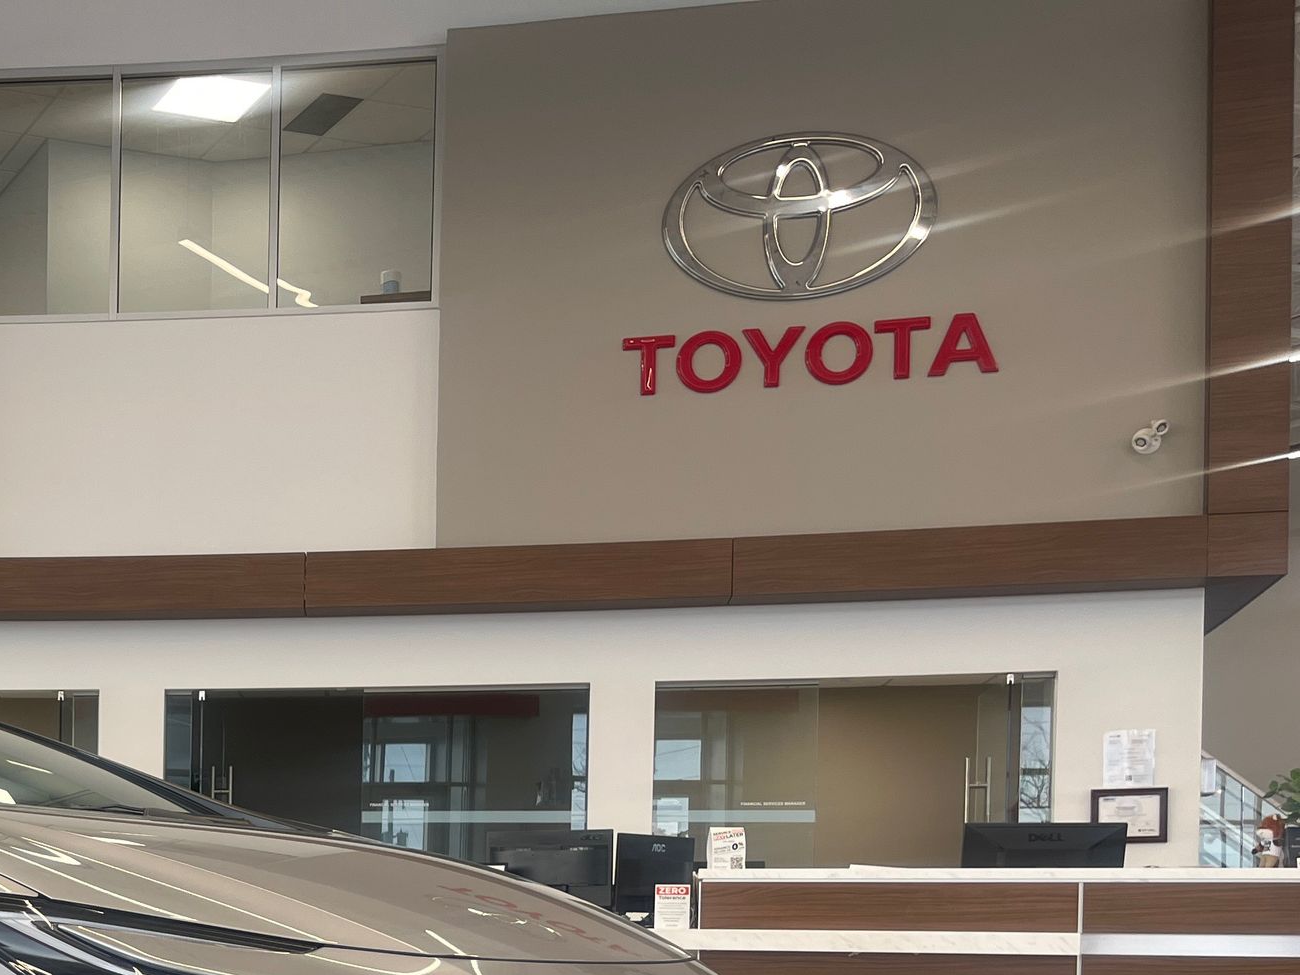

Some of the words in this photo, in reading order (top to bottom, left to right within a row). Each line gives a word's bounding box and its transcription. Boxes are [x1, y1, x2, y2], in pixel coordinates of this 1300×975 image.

[622, 312, 999, 396] TOYOTA
[1028, 833, 1064, 842] DELL
[652, 844, 666, 852] AOC
